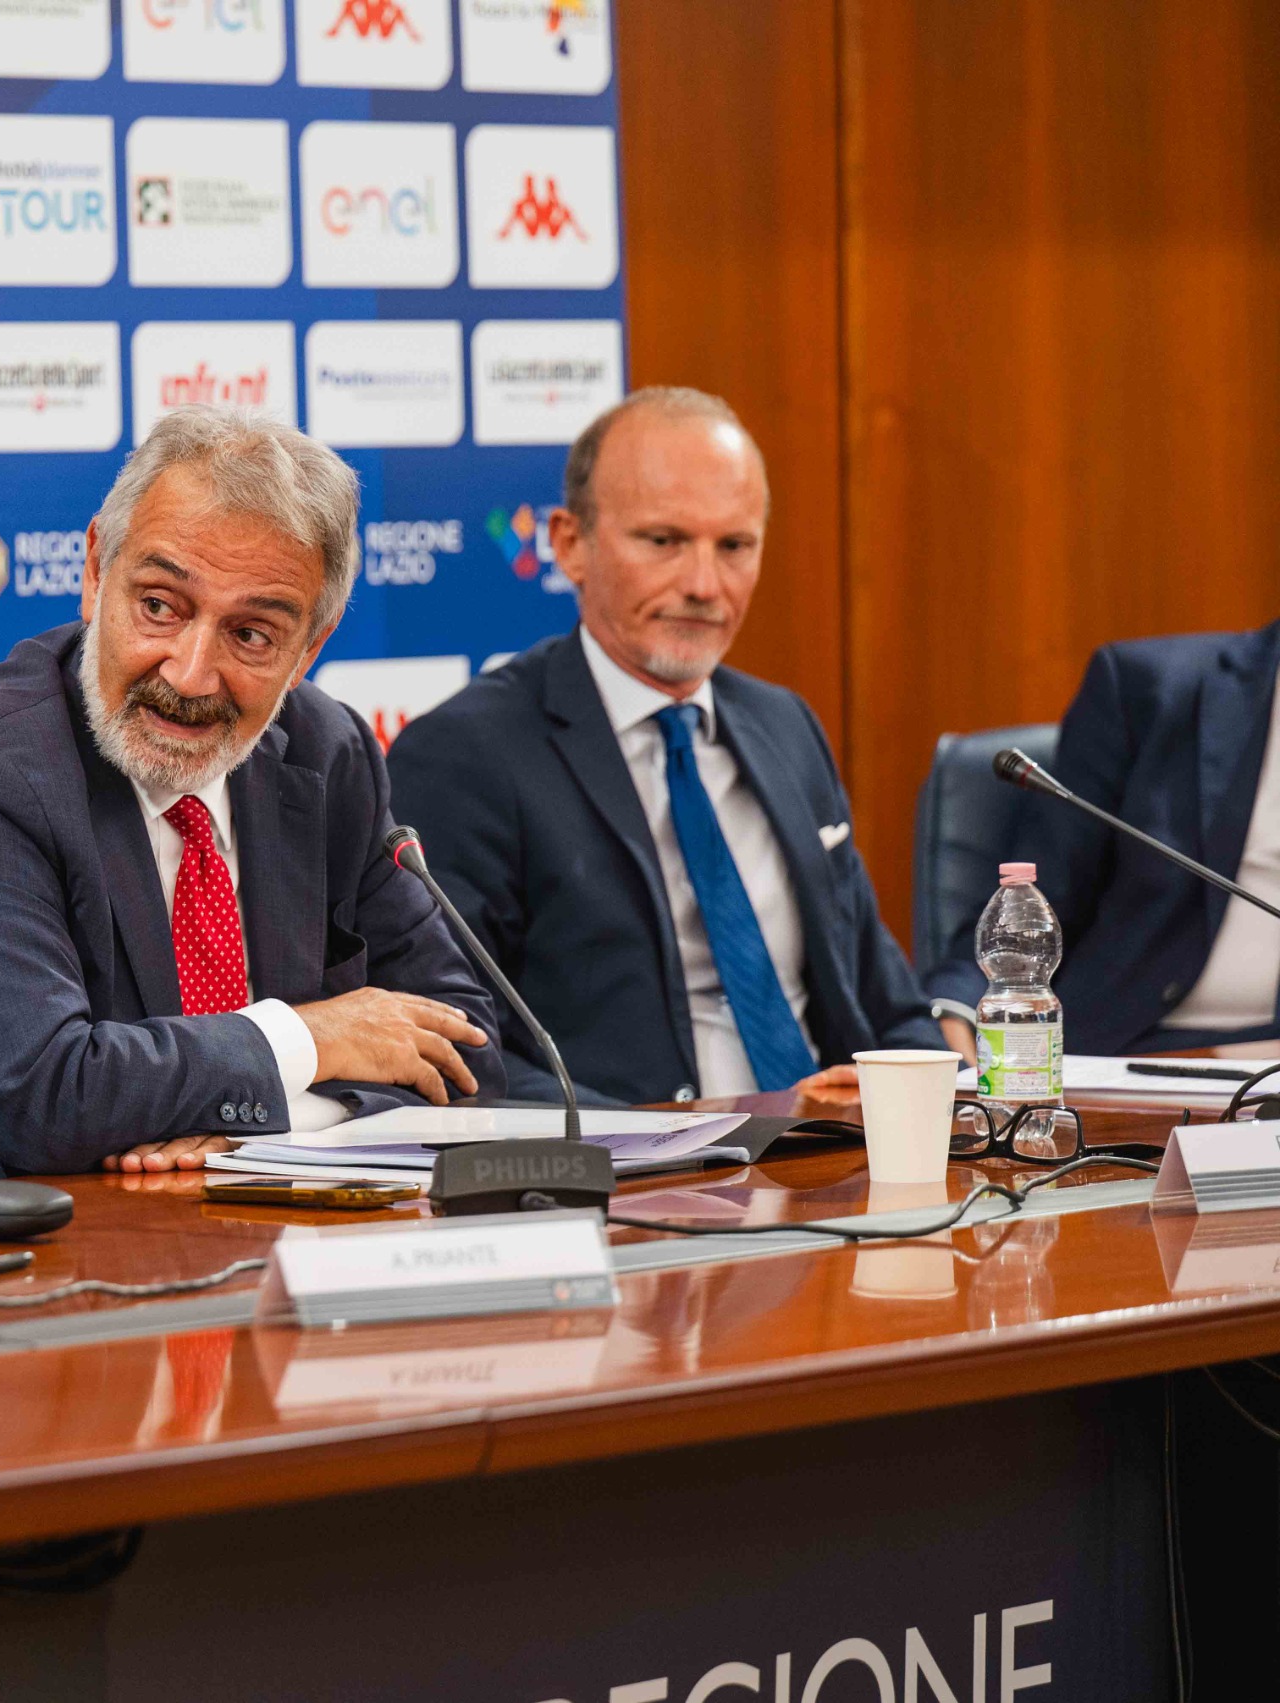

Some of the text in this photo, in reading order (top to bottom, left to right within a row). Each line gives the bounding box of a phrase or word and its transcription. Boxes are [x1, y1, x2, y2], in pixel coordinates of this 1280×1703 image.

[321, 176, 439, 236] enel
[15, 530, 86, 563] REGIO
[365, 519, 464, 553] REGIONE
[365, 550, 436, 586] LAZIO
[474, 1155, 587, 1182] PHILIPS
